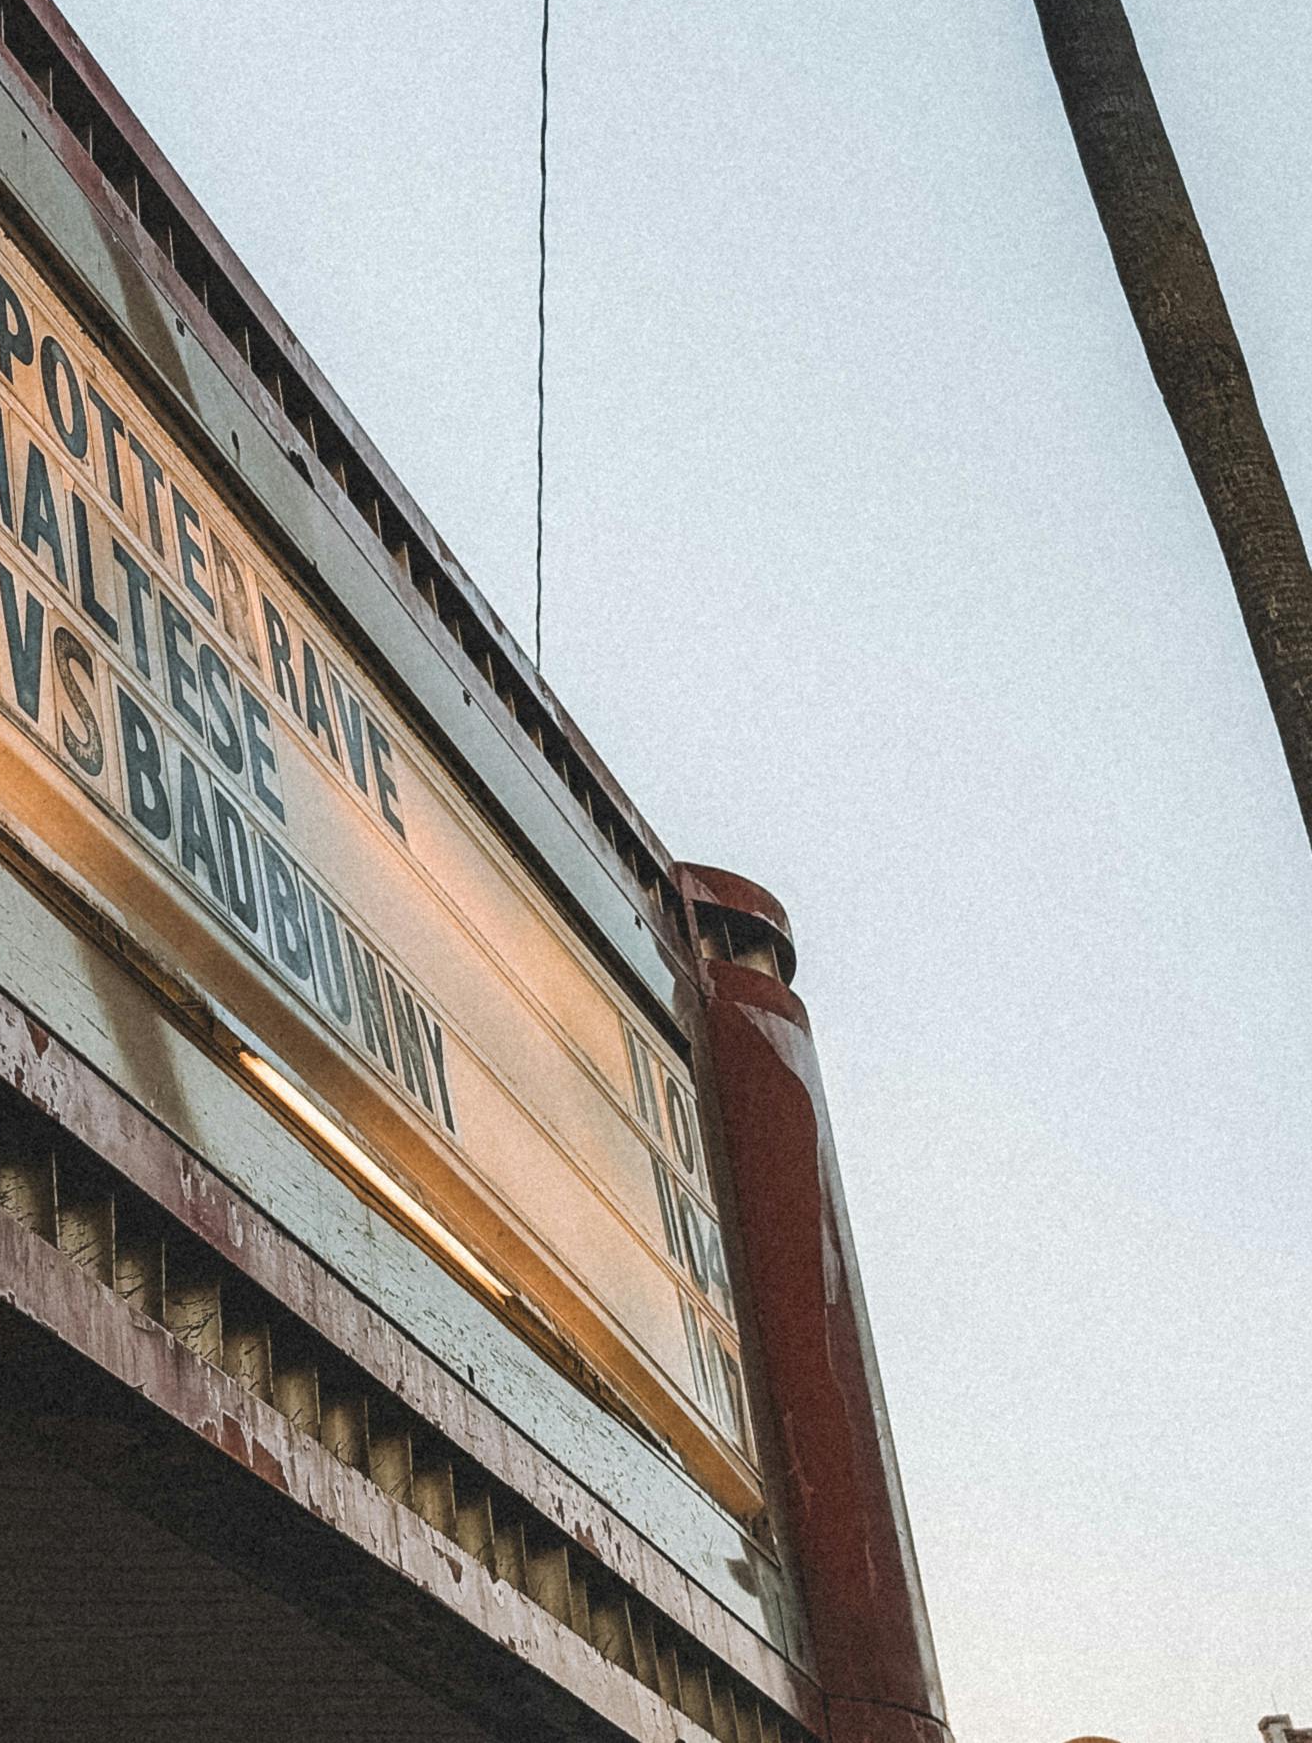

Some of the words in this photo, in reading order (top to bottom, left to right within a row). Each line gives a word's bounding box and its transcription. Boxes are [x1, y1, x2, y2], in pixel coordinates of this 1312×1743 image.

[261, 591, 407, 842] RAVE
[118, 684, 259, 934] BAD
[260, 834, 456, 1135] BUNNY
